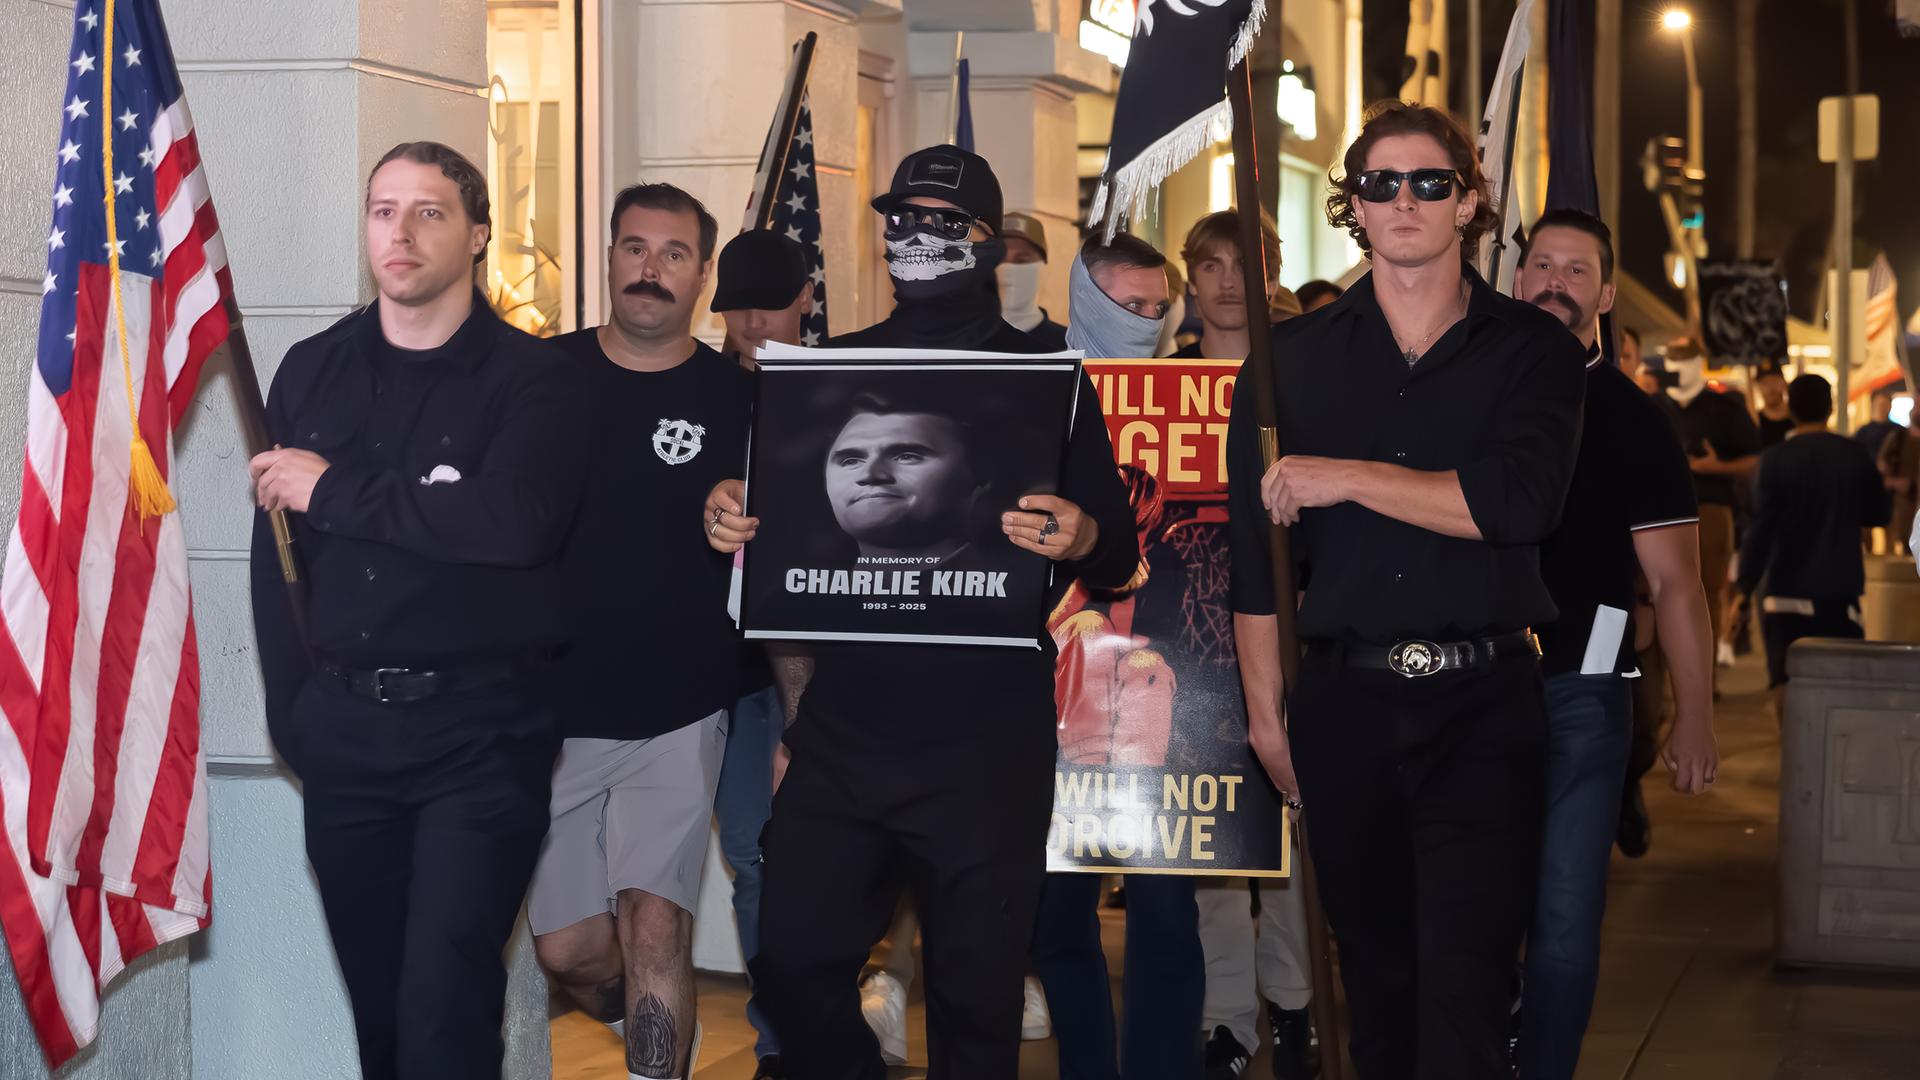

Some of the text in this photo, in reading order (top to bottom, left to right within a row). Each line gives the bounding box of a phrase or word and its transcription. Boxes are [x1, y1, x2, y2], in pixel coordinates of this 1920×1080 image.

[1090, 374, 1165, 416] ILL
[1107, 420, 1229, 483] GET
[857, 556, 941, 566] IN MEMORY OF
[785, 567, 1009, 598] CHARLIE KIRK
[862, 602, 888, 610] 1993
[899, 602, 927, 611] 2025
[1055, 771, 1243, 812] WILL NOT
